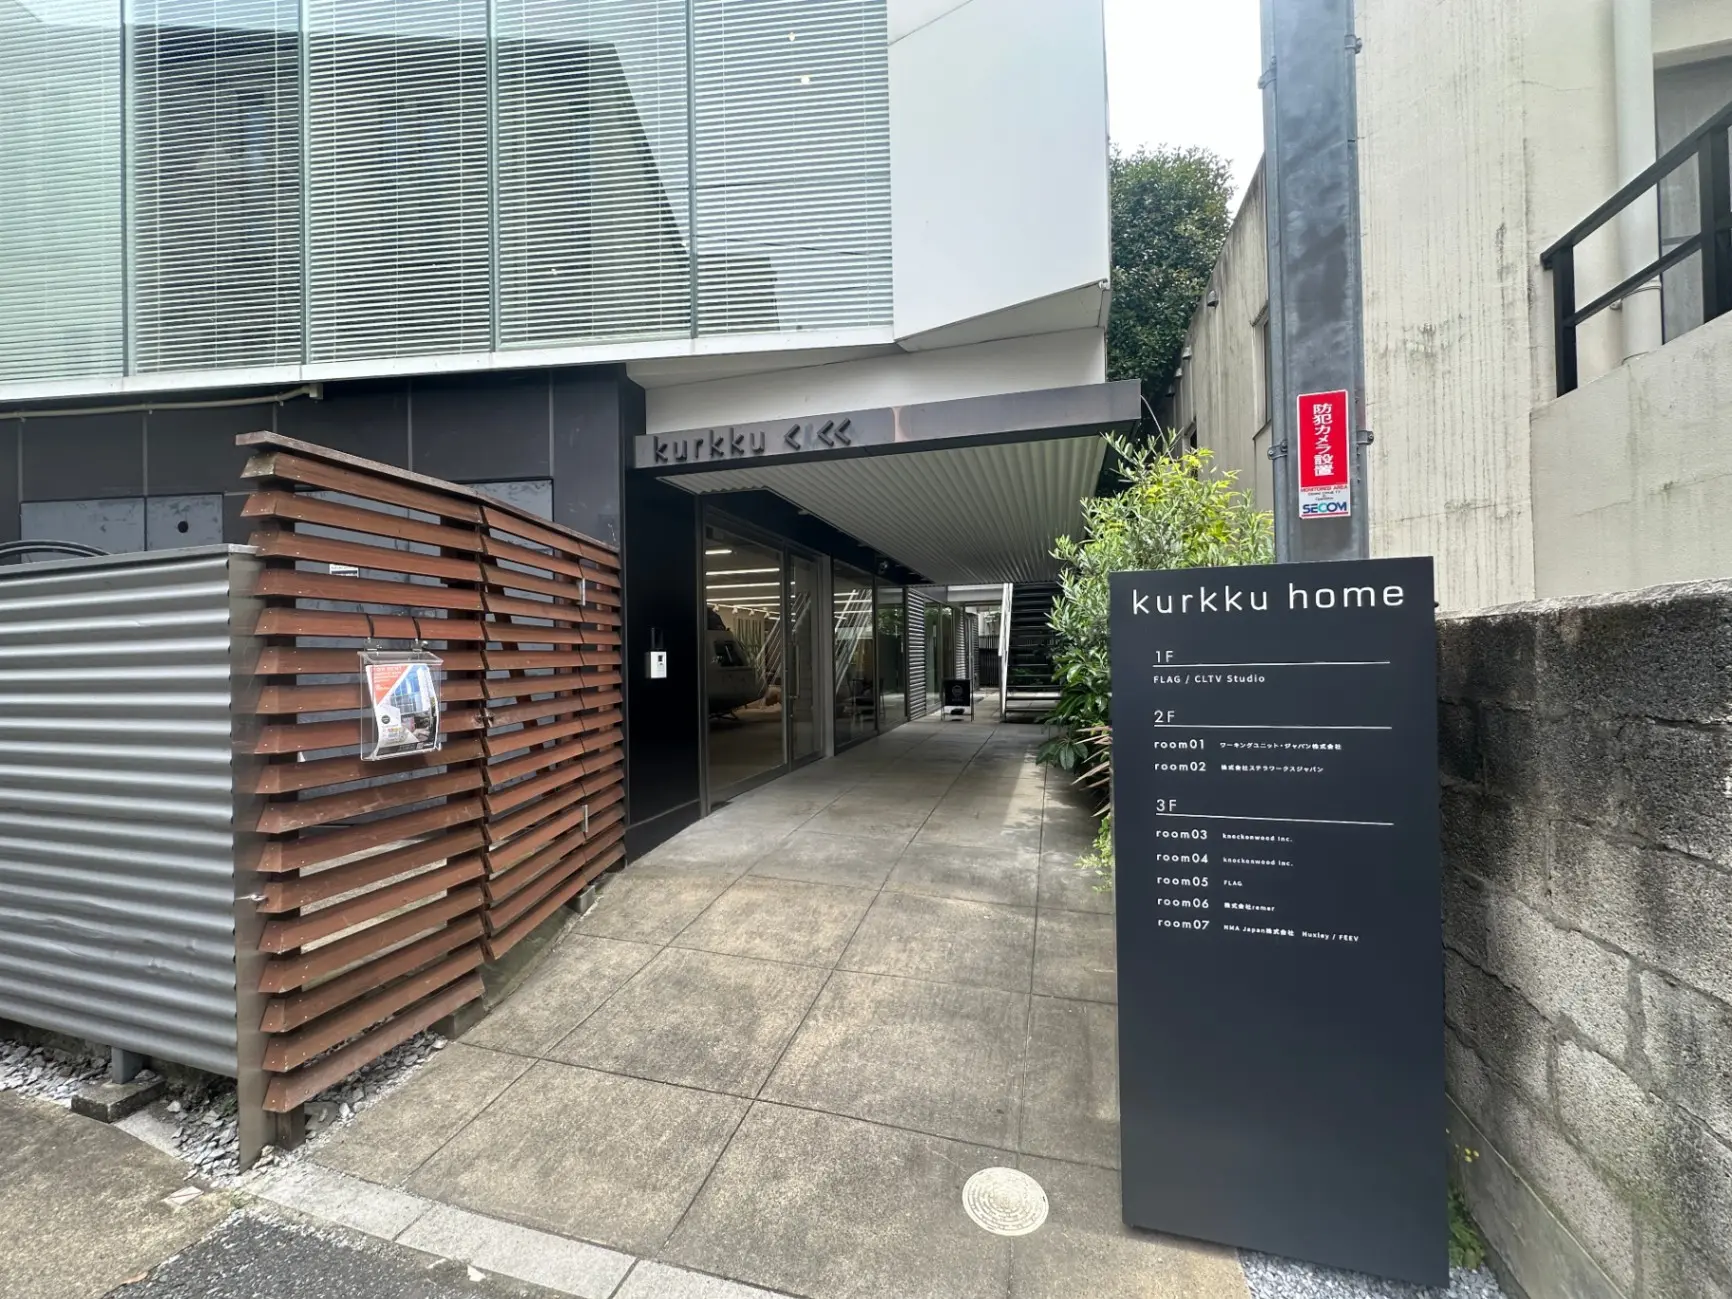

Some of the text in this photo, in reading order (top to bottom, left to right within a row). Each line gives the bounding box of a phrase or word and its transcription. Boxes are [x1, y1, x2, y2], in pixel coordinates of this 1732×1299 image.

[653, 427, 765, 463] kurkku
[1312, 403, 1334, 476] 防犯カメラ設置
[1303, 502, 1347, 514] SECOM
[1132, 582, 1404, 615] kurkku home
[1155, 650, 1174, 663] 1F
[1153, 675, 1181, 684] FLAG
[1194, 674, 1222, 683] CLTV
[1226, 673, 1266, 683] Studio
[1154, 710, 1175, 723] 2F
[1154, 738, 1205, 750] room01
[1154, 761, 1206, 772] room02
[1220, 764, 1324, 773] 株式会社ステラワークスジャパン
[1156, 799, 1177, 812] 3F
[1156, 828, 1208, 840] room03
[1156, 852, 1209, 864] room04
[1157, 876, 1209, 888] room05
[1223, 879, 1243, 887] FLAG
[1157, 897, 1210, 909] room06
[1158, 919, 1210, 931] room07
[1301, 931, 1330, 941] Huxley
